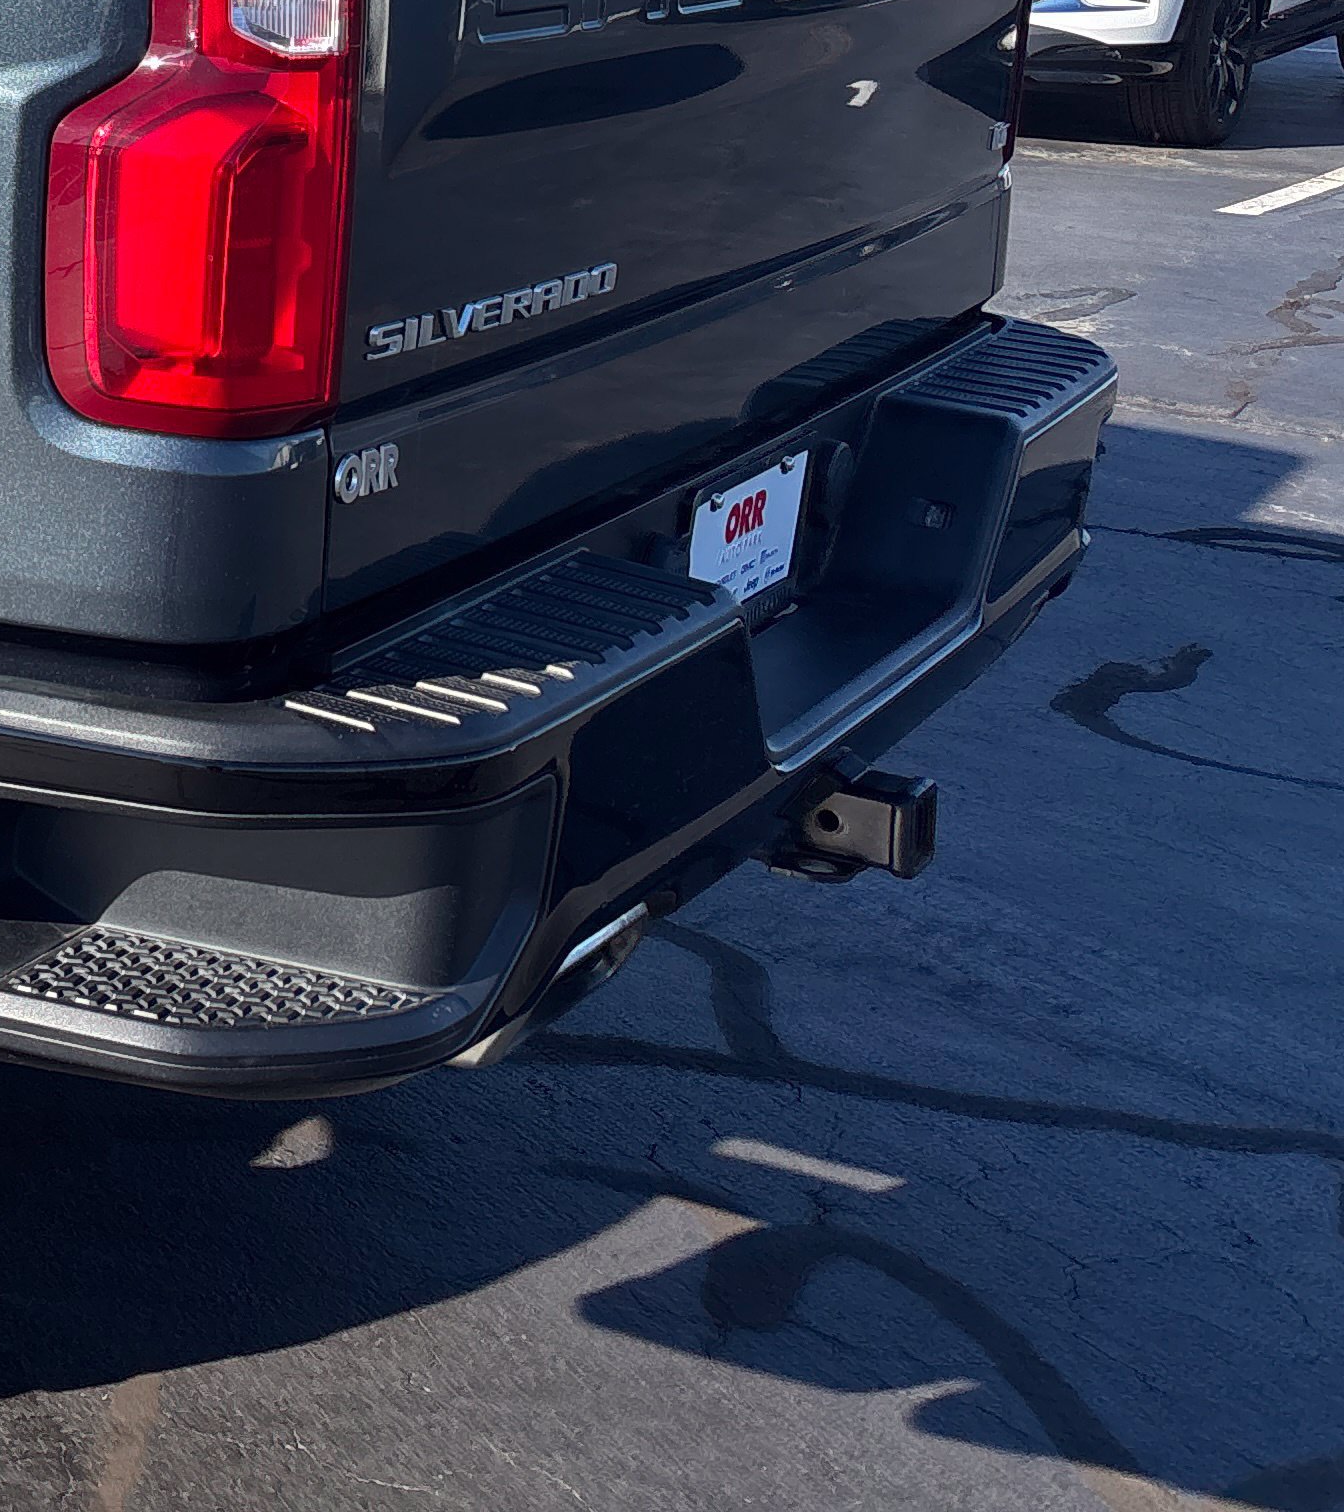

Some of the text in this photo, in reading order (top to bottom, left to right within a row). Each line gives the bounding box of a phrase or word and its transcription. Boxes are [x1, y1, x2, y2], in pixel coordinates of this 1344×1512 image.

[365, 262, 618, 361] SILVERADO
[334, 442, 400, 505] ORR
[724, 489, 768, 545] ORR
